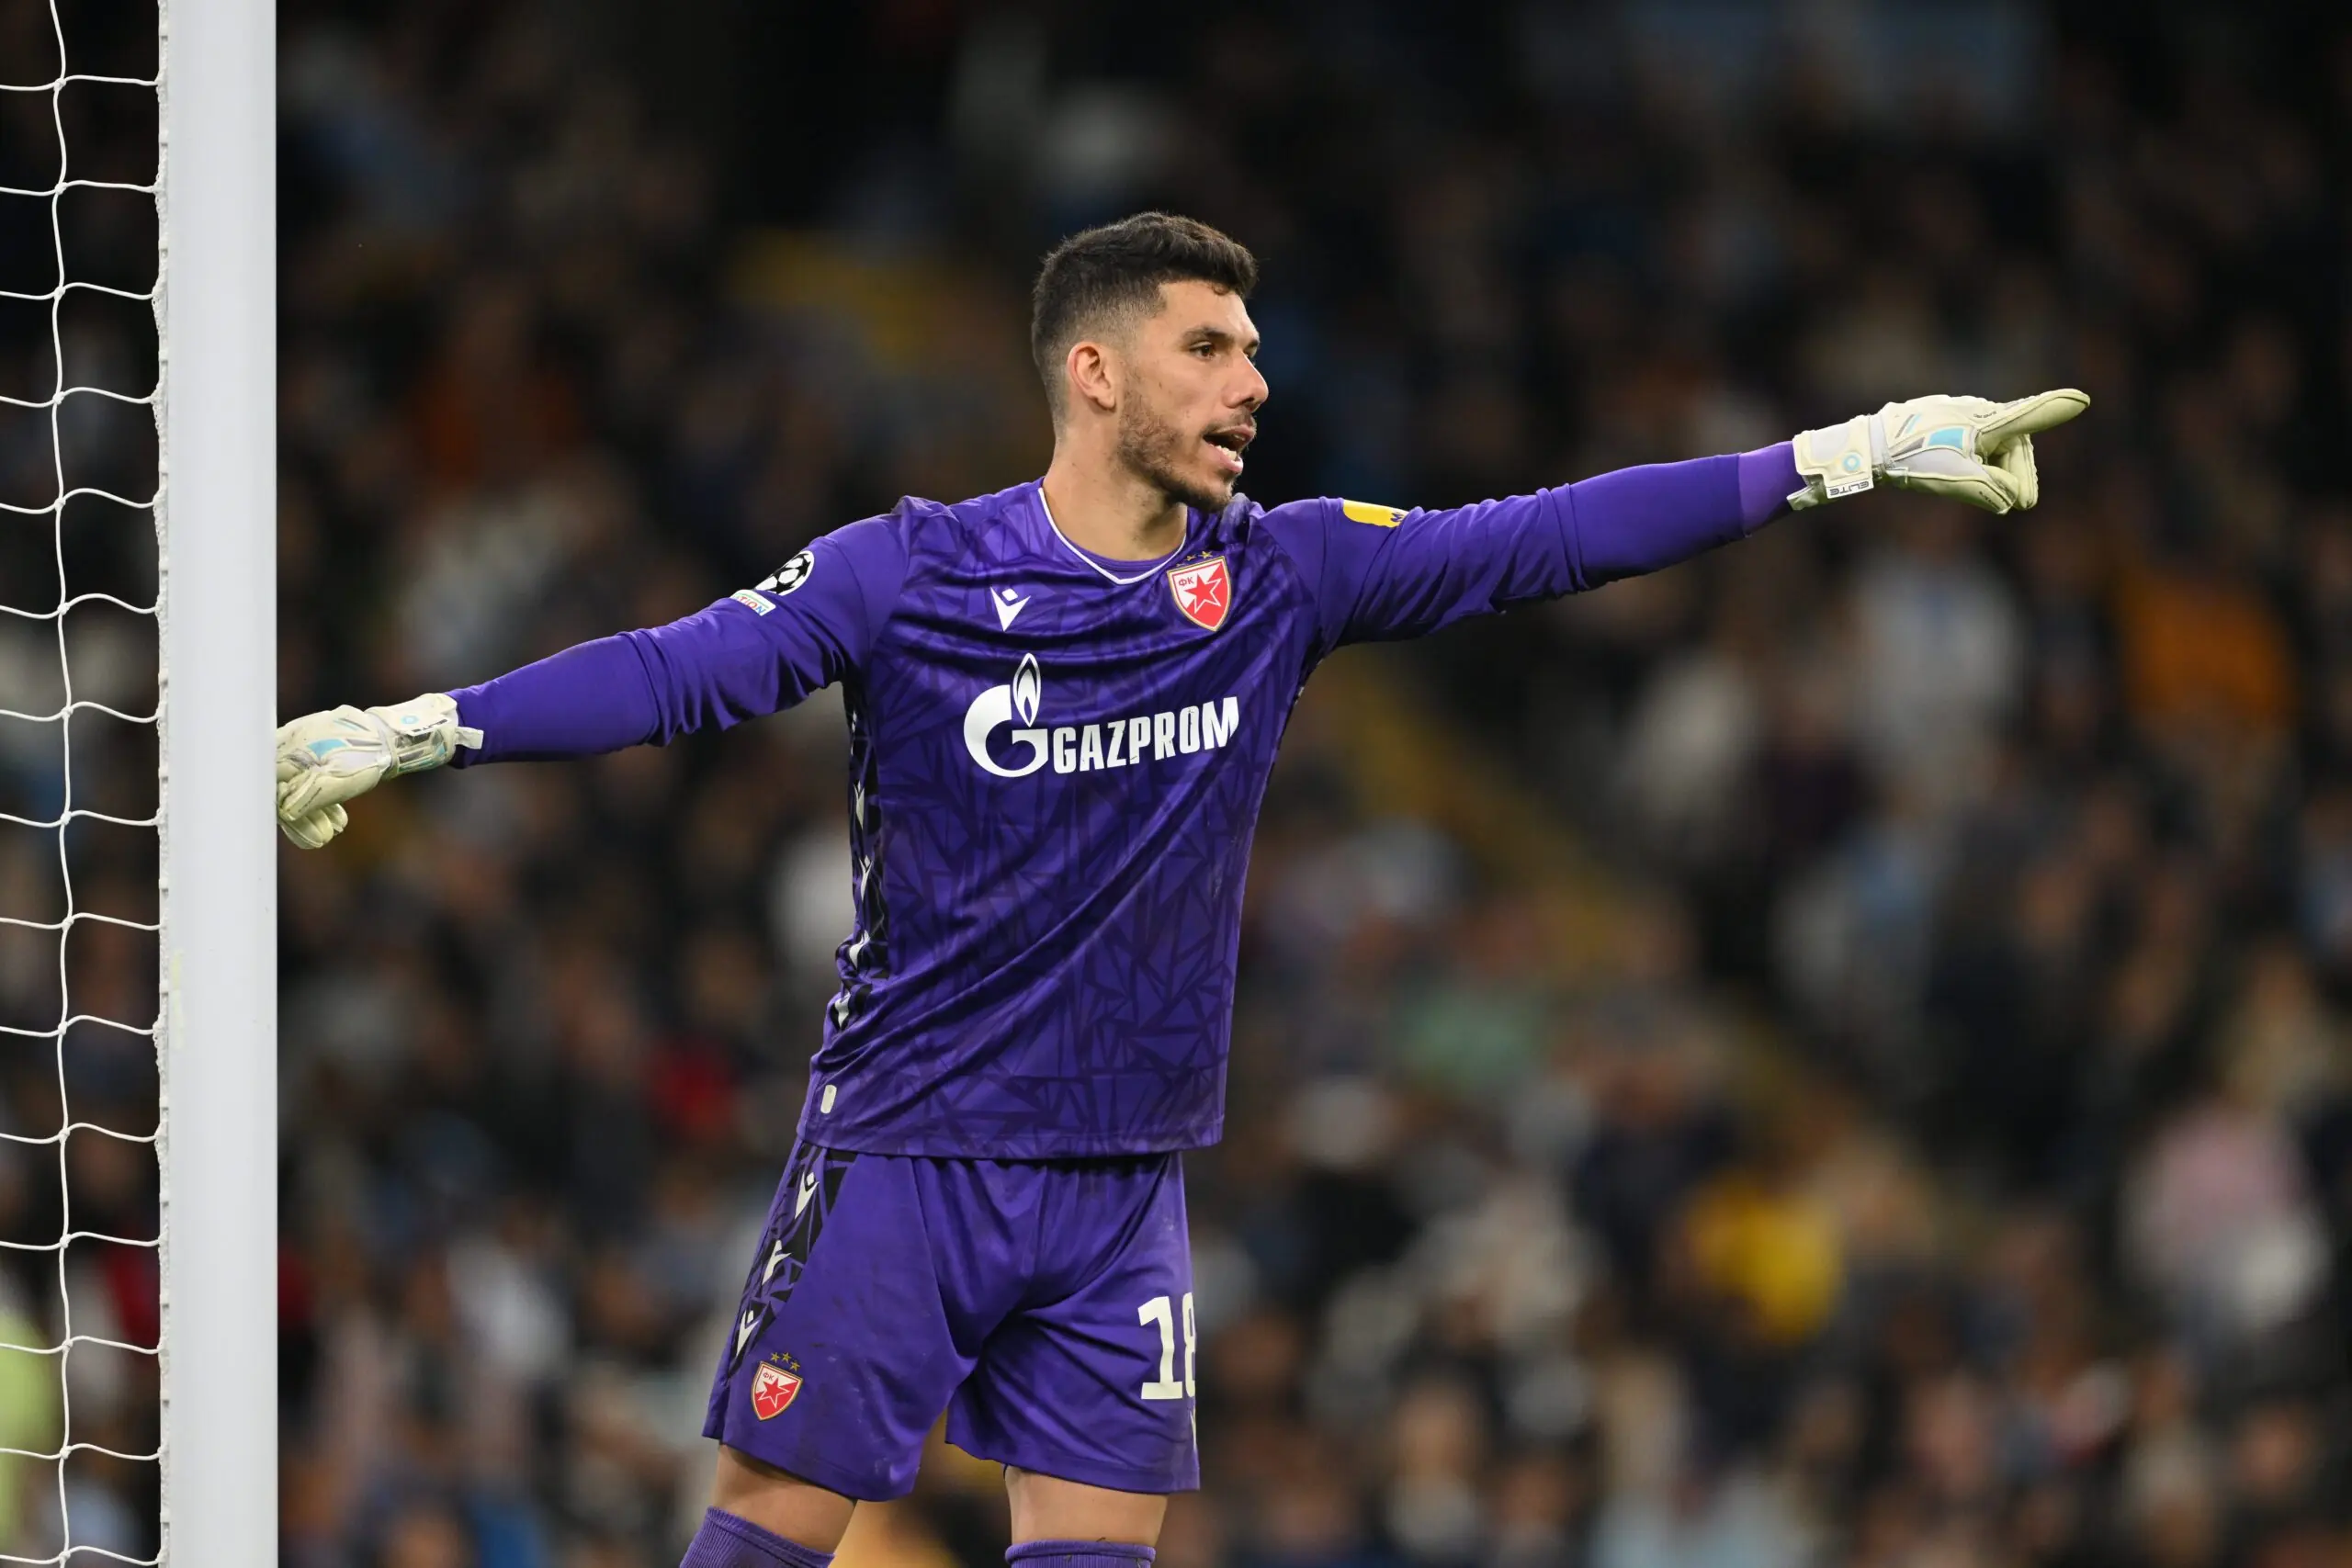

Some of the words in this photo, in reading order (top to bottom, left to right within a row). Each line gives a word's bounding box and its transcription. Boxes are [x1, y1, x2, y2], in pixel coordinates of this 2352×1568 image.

[1830, 480, 1870, 496] ELITE
[1178, 576, 1194, 586] ФК
[739, 596, 766, 614] TION
[1053, 696, 1239, 773] GAZPROM
[1137, 1292, 1196, 1399] 18
